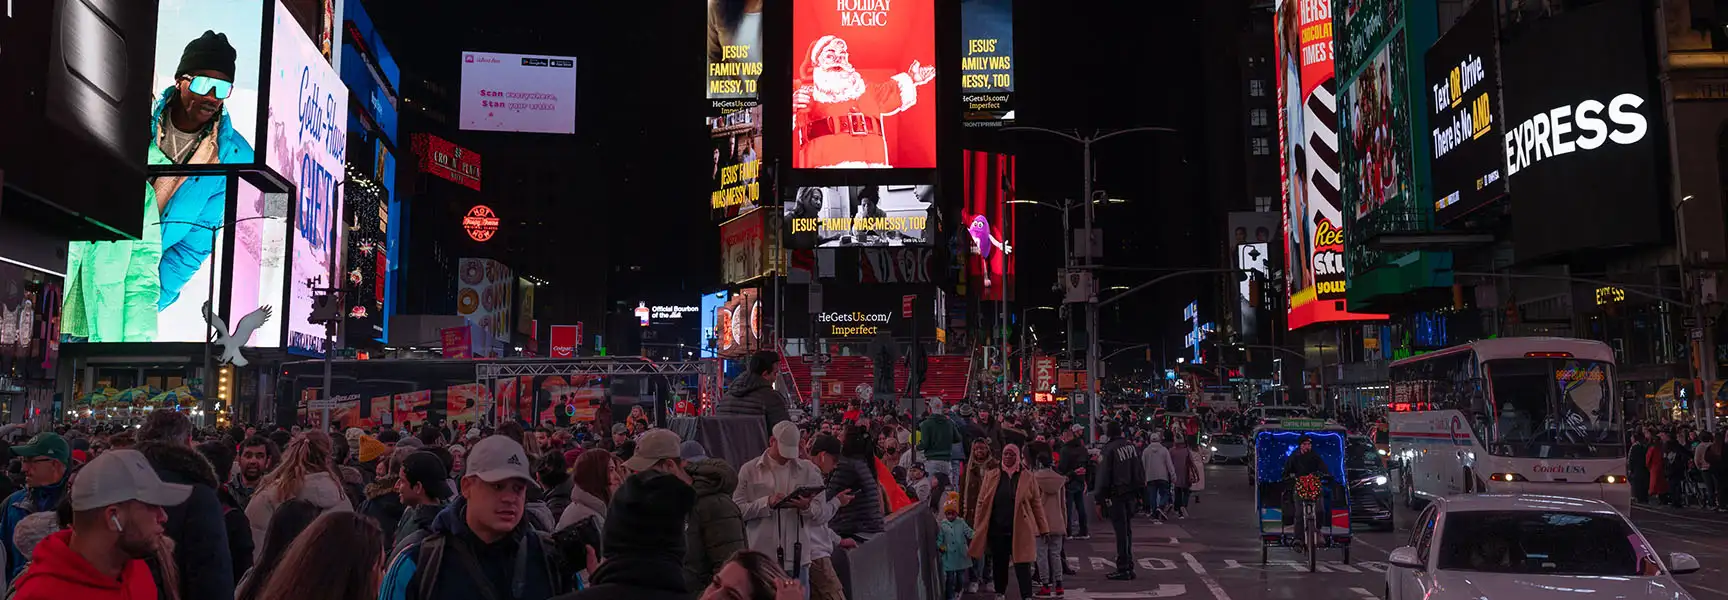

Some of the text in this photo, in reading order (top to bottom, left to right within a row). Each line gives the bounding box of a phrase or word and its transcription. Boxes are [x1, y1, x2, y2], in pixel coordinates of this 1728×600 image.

[837, 0, 891, 11] HOLIDAY
[841, 11, 887, 27] MAGIC
[722, 44, 750, 61] JESUS'
[968, 39, 998, 56] JESUS'
[1303, 42, 1326, 66] TIMES
[709, 62, 763, 76] FAMILY WAS
[961, 56, 1010, 71] AMILY WAS
[710, 80, 757, 95] MESSY, TO
[992, 73, 1010, 88] TOO
[1433, 53, 1485, 114] Text OR Drive.
[480, 89, 503, 97] Scan
[481, 100, 505, 108] Stan
[1433, 124, 1453, 160] There
[1453, 114, 1461, 147] Is
[1461, 107, 1472, 142] No
[1505, 93, 1648, 177] EXPRESS
[473, 208, 490, 217] HOT
[822, 217, 852, 231] FAMILY
[853, 217, 875, 231] WAS
[875, 216, 907, 232] MESSY,
[909, 215, 926, 230] TOO
[472, 229, 490, 239] NOW
[831, 325, 877, 337] Imperfect
[1036, 358, 1054, 392] tkts
[1532, 464, 1587, 474] Coach USA
